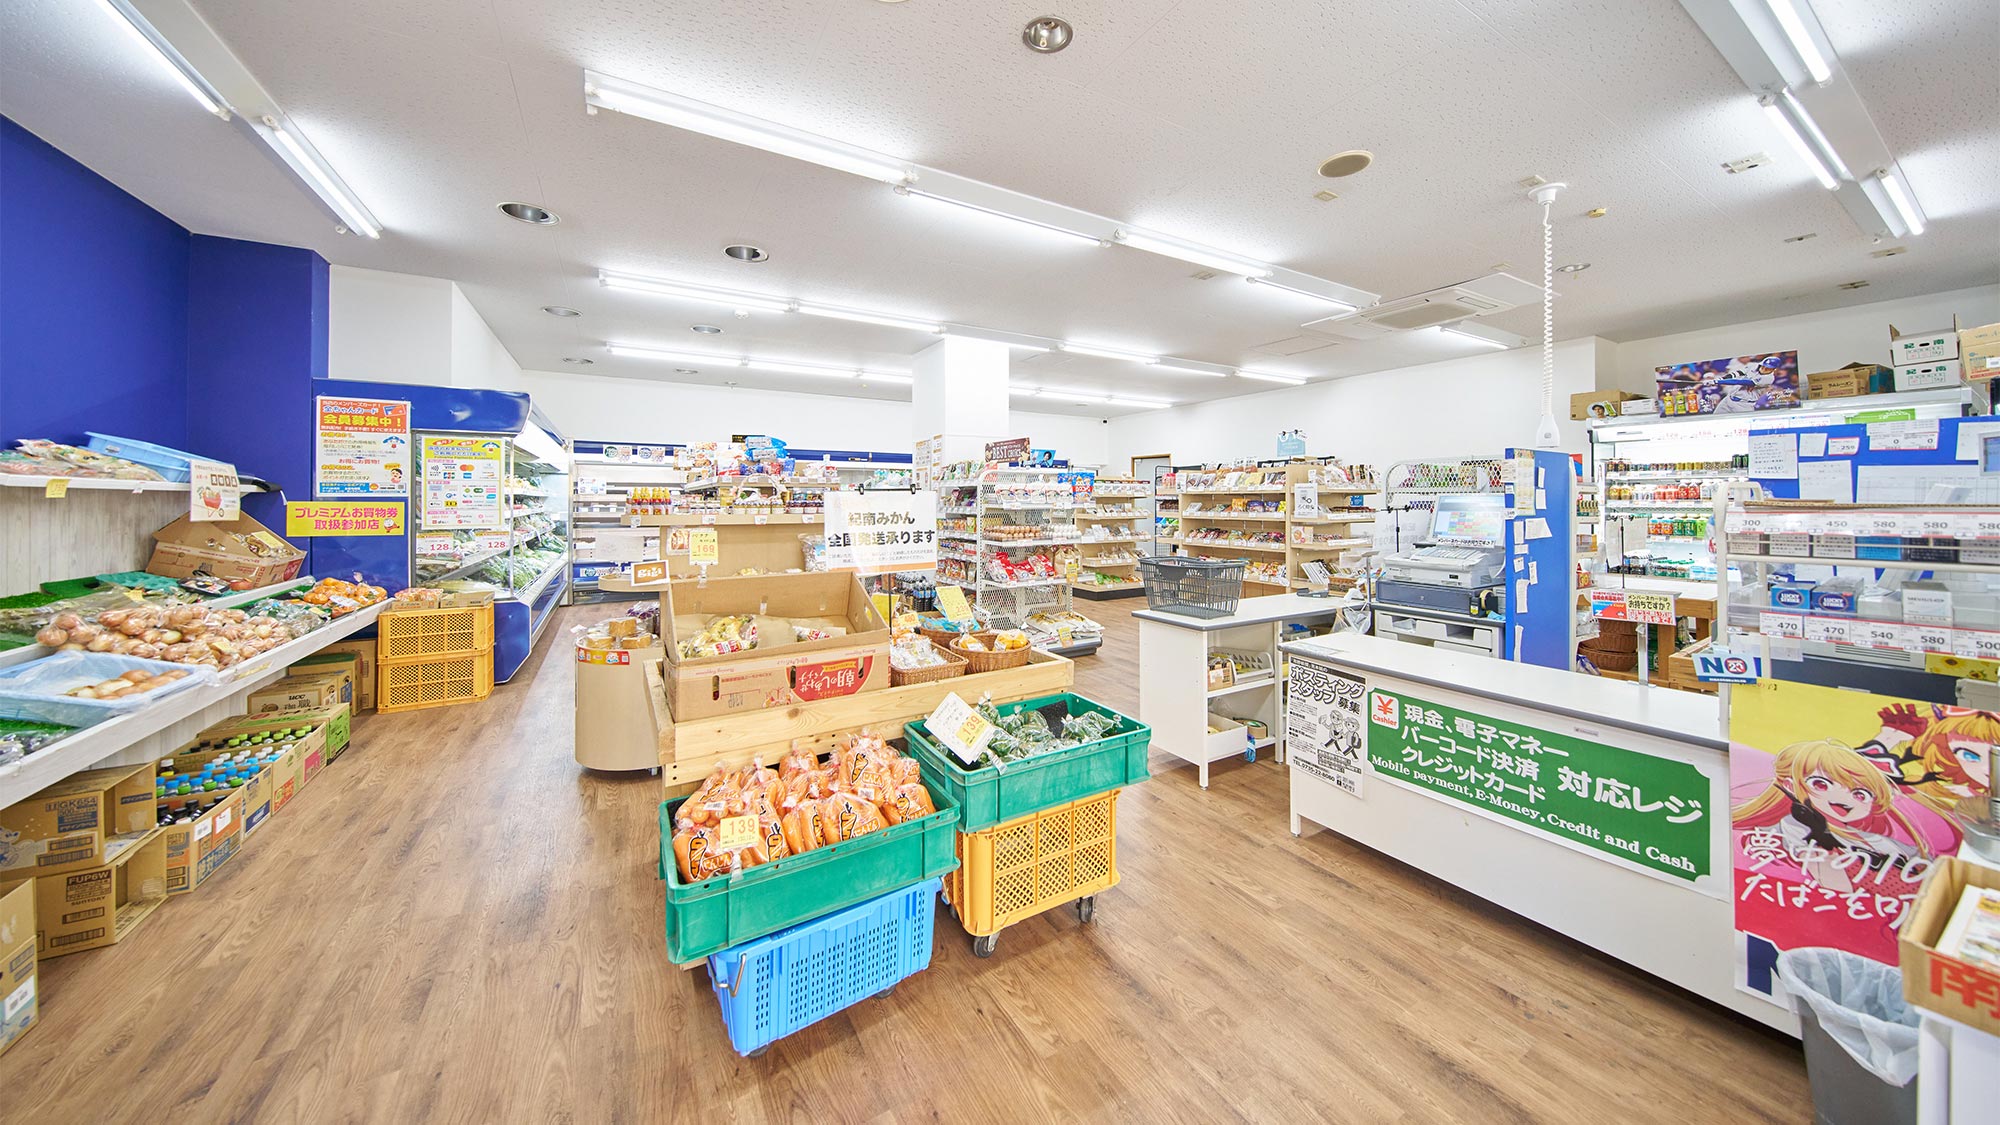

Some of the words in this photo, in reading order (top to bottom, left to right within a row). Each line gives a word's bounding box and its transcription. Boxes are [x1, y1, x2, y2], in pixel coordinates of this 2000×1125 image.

[324, 414, 401, 427] 会員募集中！
[295, 507, 398, 519] プレミアムお買物券
[848, 511, 916, 527] 紀南みかん
[314, 519, 379, 530] 取扱参加店
[1826, 520, 1848, 528] 450
[1923, 521, 1948, 529] 580
[431, 543, 449, 551] 128
[488, 541, 506, 549] 128
[828, 530, 935, 547] 全国発送承ります
[1777, 622, 1798, 631] 470
[1823, 626, 1845, 635] 470
[1871, 630, 1894, 640] 540
[1920, 635, 1945, 645] 580
[1290, 666, 1365, 699] ポスティング
[1290, 681, 1336, 705] スタッフ
[1338, 696, 1361, 715] 募集
[962, 715, 981, 736] 139
[1373, 714, 1397, 726] Cashier
[1401, 725, 1539, 782] バーコード決済
[1401, 745, 1546, 804] クレジットカード
[1557, 766, 1703, 824] 対応レジ
[1371, 754, 1411, 776] Mobile
[1413, 769, 1474, 798] payment,
[1475, 788, 1546, 823] E-Money,
[1546, 813, 1601, 840] Credit
[1604, 833, 1641, 855] and
[1645, 846, 1697, 873] Cash
[729, 818, 756, 836] 139
